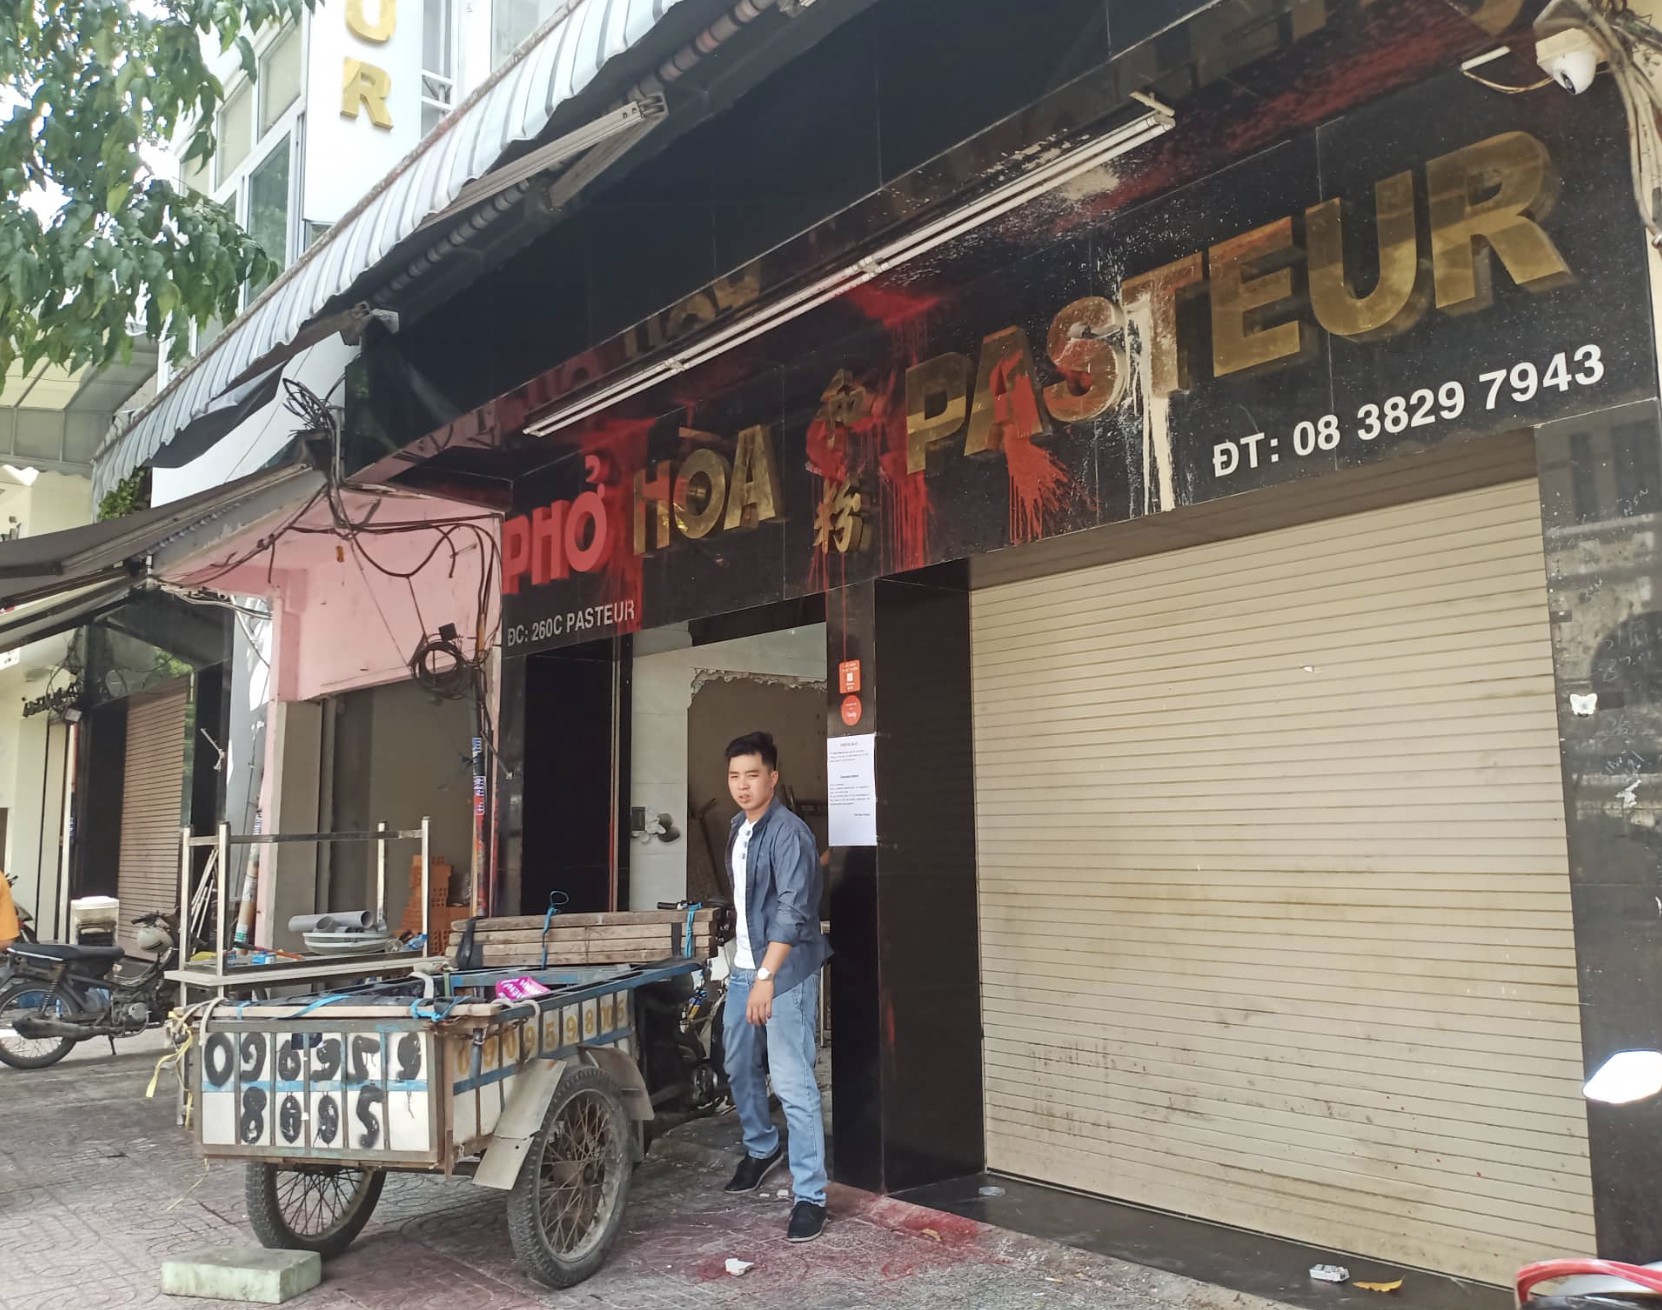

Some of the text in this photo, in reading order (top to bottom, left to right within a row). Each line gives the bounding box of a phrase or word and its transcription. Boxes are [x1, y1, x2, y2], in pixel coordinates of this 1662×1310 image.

[906, 131, 1569, 475] PASTEUR
[1212, 343, 1605, 477] ĐT: 08 3829 7943
[502, 425, 776, 594] PHỞ HÒA
[507, 600, 635, 647] ĐC: 260C PASTEUR
